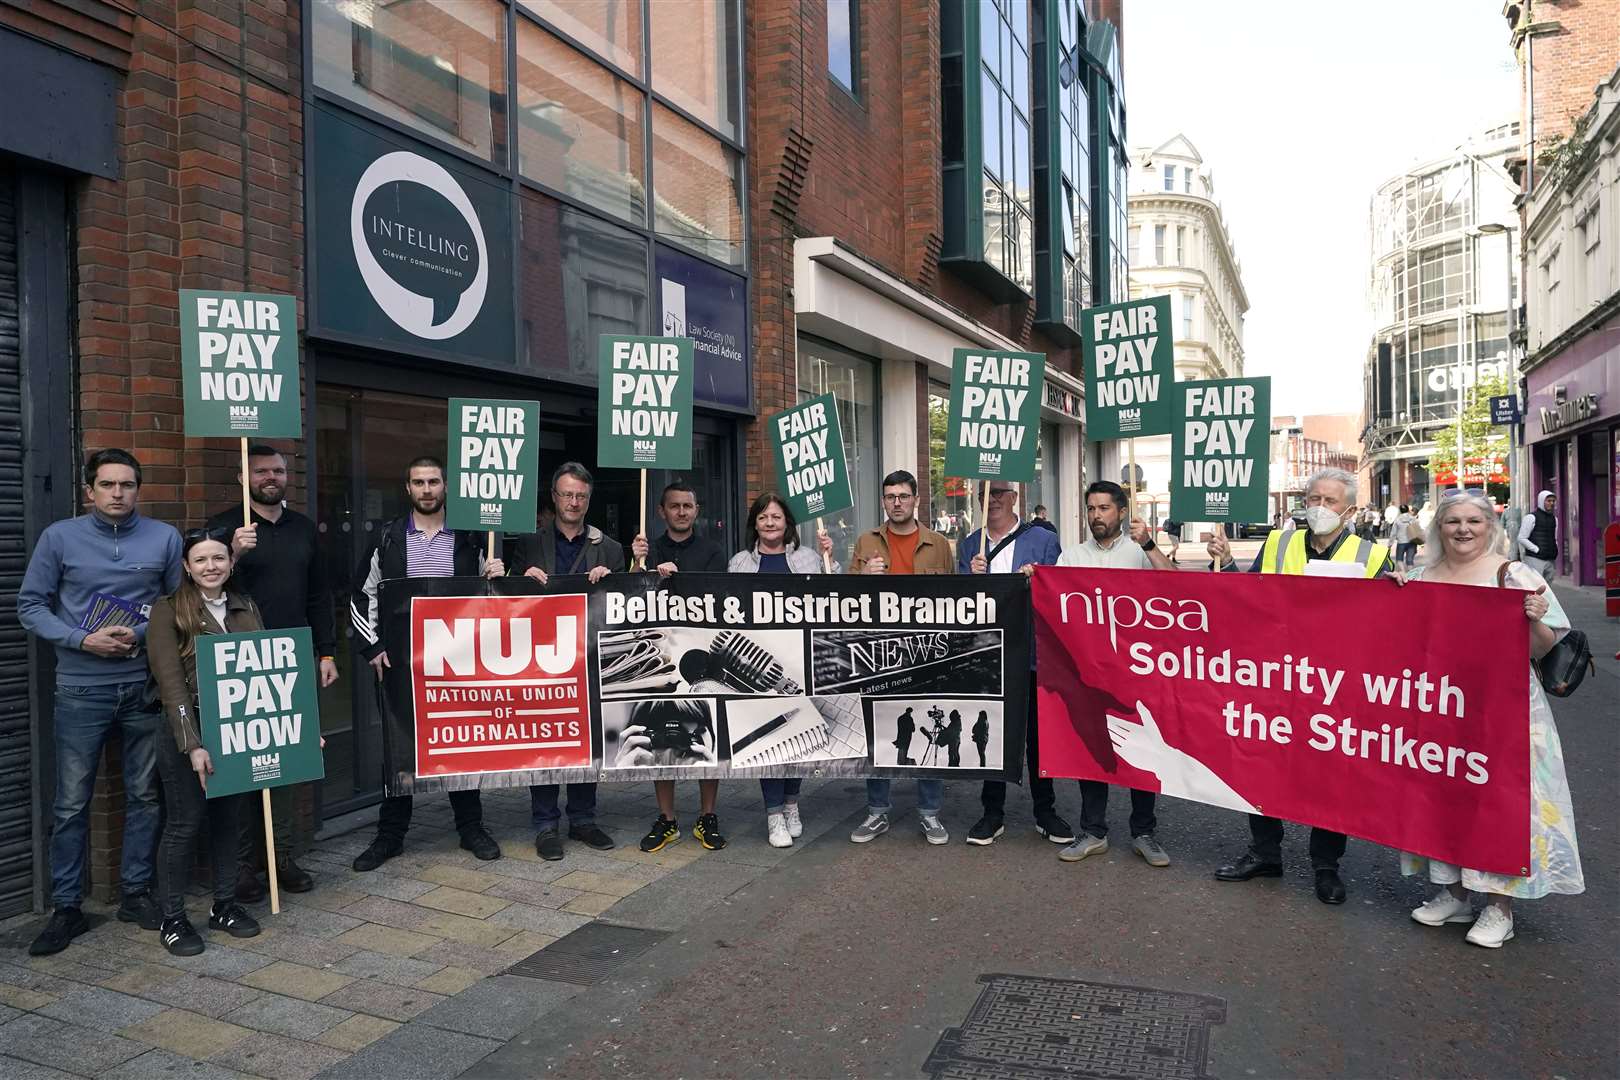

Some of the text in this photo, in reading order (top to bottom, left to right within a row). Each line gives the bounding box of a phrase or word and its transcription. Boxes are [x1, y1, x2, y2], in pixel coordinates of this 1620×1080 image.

[373, 216, 469, 262] INTELLING
[382, 249, 463, 278] Clever communication
[197, 298, 280, 331] FAIR
[1094, 306, 1157, 341] FAIR
[688, 322, 702, 335] Law
[702, 327, 724, 346] Society
[199, 332, 280, 369] PAY
[613, 342, 678, 371] FAIR
[720, 346, 742, 361] Advice
[1096, 337, 1158, 377] PAY
[965, 356, 1030, 386] FAIR
[201, 372, 282, 401] NOW
[613, 373, 678, 407] PAY
[1097, 375, 1160, 407] NOW
[1186, 385, 1254, 416] FAIR
[230, 406, 257, 416] NUJ
[962, 387, 1028, 421] PAY
[1119, 408, 1140, 419] NUJ
[462, 406, 524, 434] FAIR
[612, 409, 678, 436] NOW
[778, 403, 828, 441] FAIR
[634, 440, 656, 450] NUJ
[782, 428, 829, 472] PAY
[960, 422, 1025, 450] NOW
[1185, 419, 1254, 455] PAY
[461, 437, 524, 470] PAY
[980, 452, 1001, 462] NUJ
[460, 473, 523, 499] NOW
[787, 459, 834, 497] NOW
[1184, 459, 1253, 487] NOW
[481, 503, 502, 512] NUJ
[806, 491, 823, 503] NUJ
[1206, 492, 1229, 501] NUJ
[606, 590, 995, 624] Belfast & District Branch
[1061, 588, 1208, 653] nipsa
[215, 637, 297, 674] FAIR
[424, 616, 577, 676] NUJ
[847, 632, 949, 677] NEWS
[217, 672, 298, 718] PAY
[426, 686, 577, 703] NATIONAL UNION
[860, 676, 913, 695] Latest news
[1130, 643, 1464, 717] Solidarity with
[494, 707, 513, 719] OF
[221, 714, 301, 754] NOW
[429, 722, 579, 744] JOURNALISTS
[1223, 701, 1488, 784] the Strikers
[252, 753, 280, 767] NUJ
